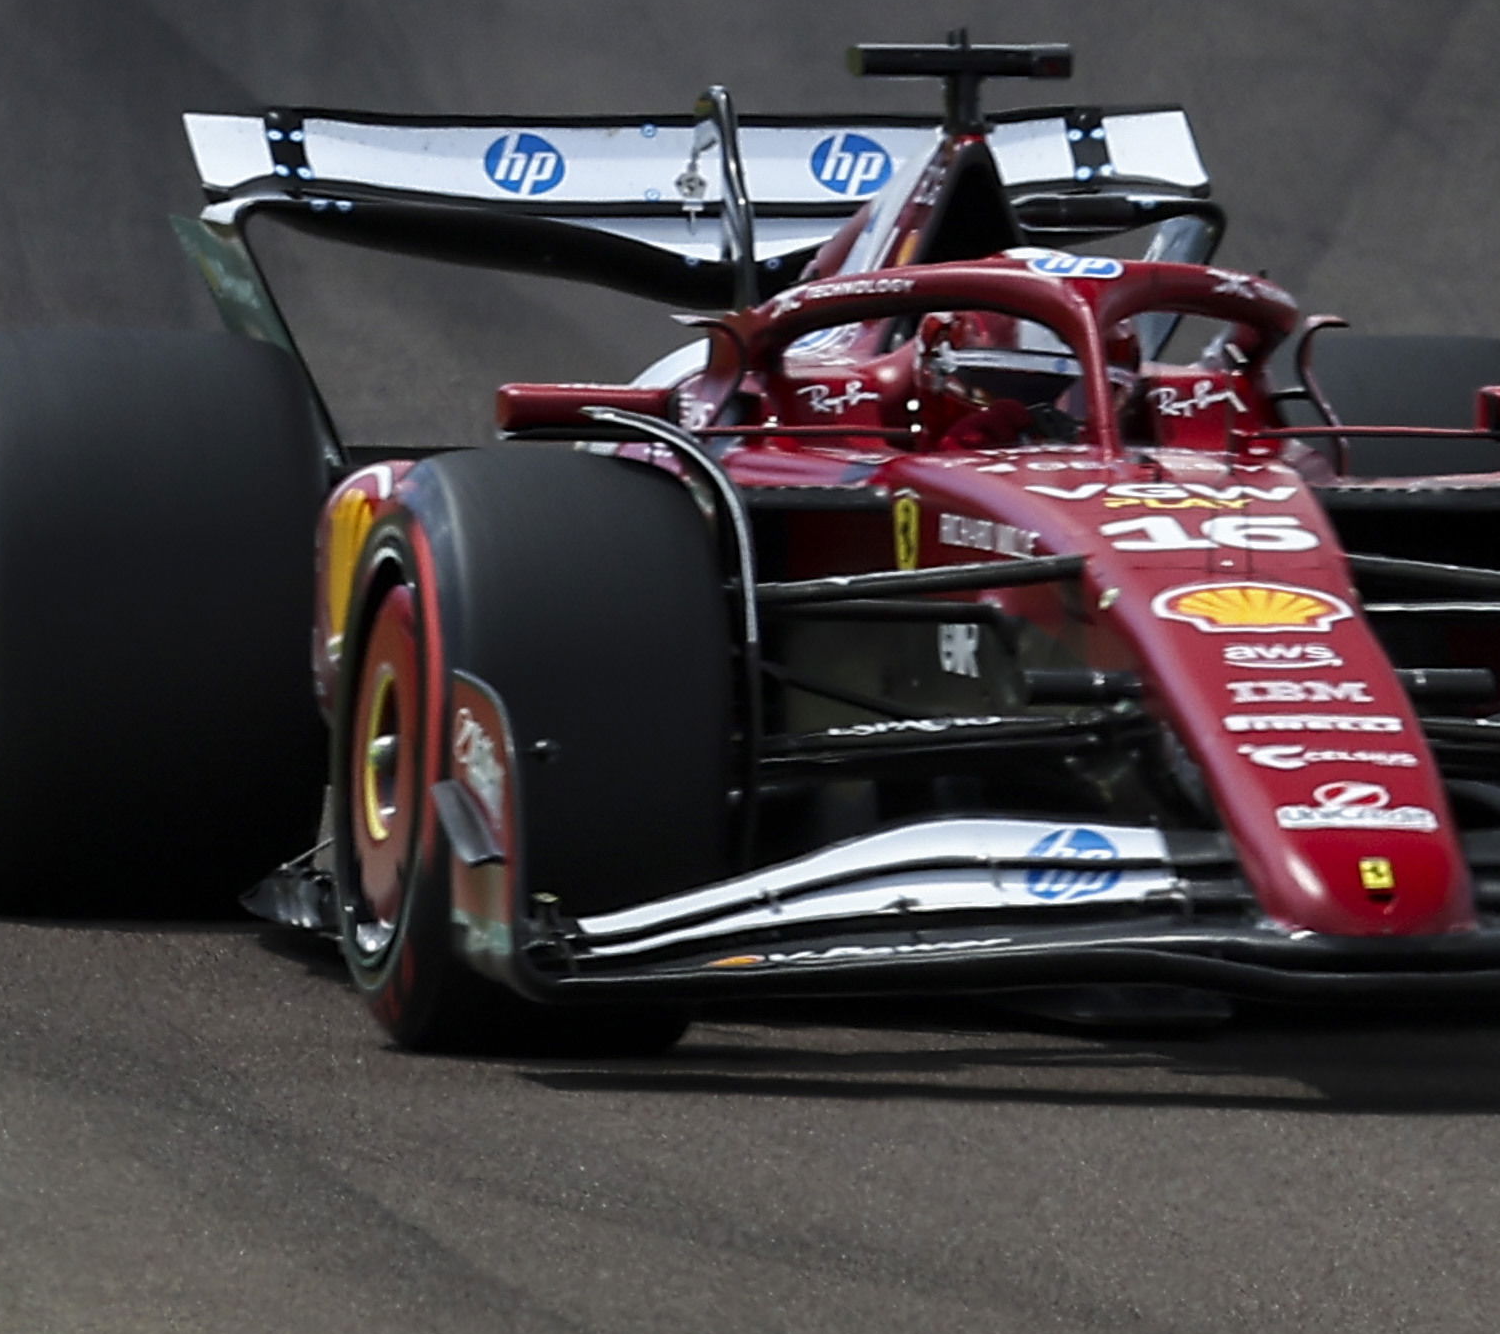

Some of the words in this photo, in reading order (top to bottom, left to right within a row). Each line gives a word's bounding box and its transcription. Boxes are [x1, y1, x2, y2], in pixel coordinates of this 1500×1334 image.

[493, 132, 558, 196] hp
[820, 132, 885, 196] hp
[1023, 482, 1298, 500] VGW
[1100, 516, 1321, 552] 16
[1223, 643, 1337, 662] aws
[1225, 681, 1375, 703] IBM
[1034, 828, 1114, 901] hp
